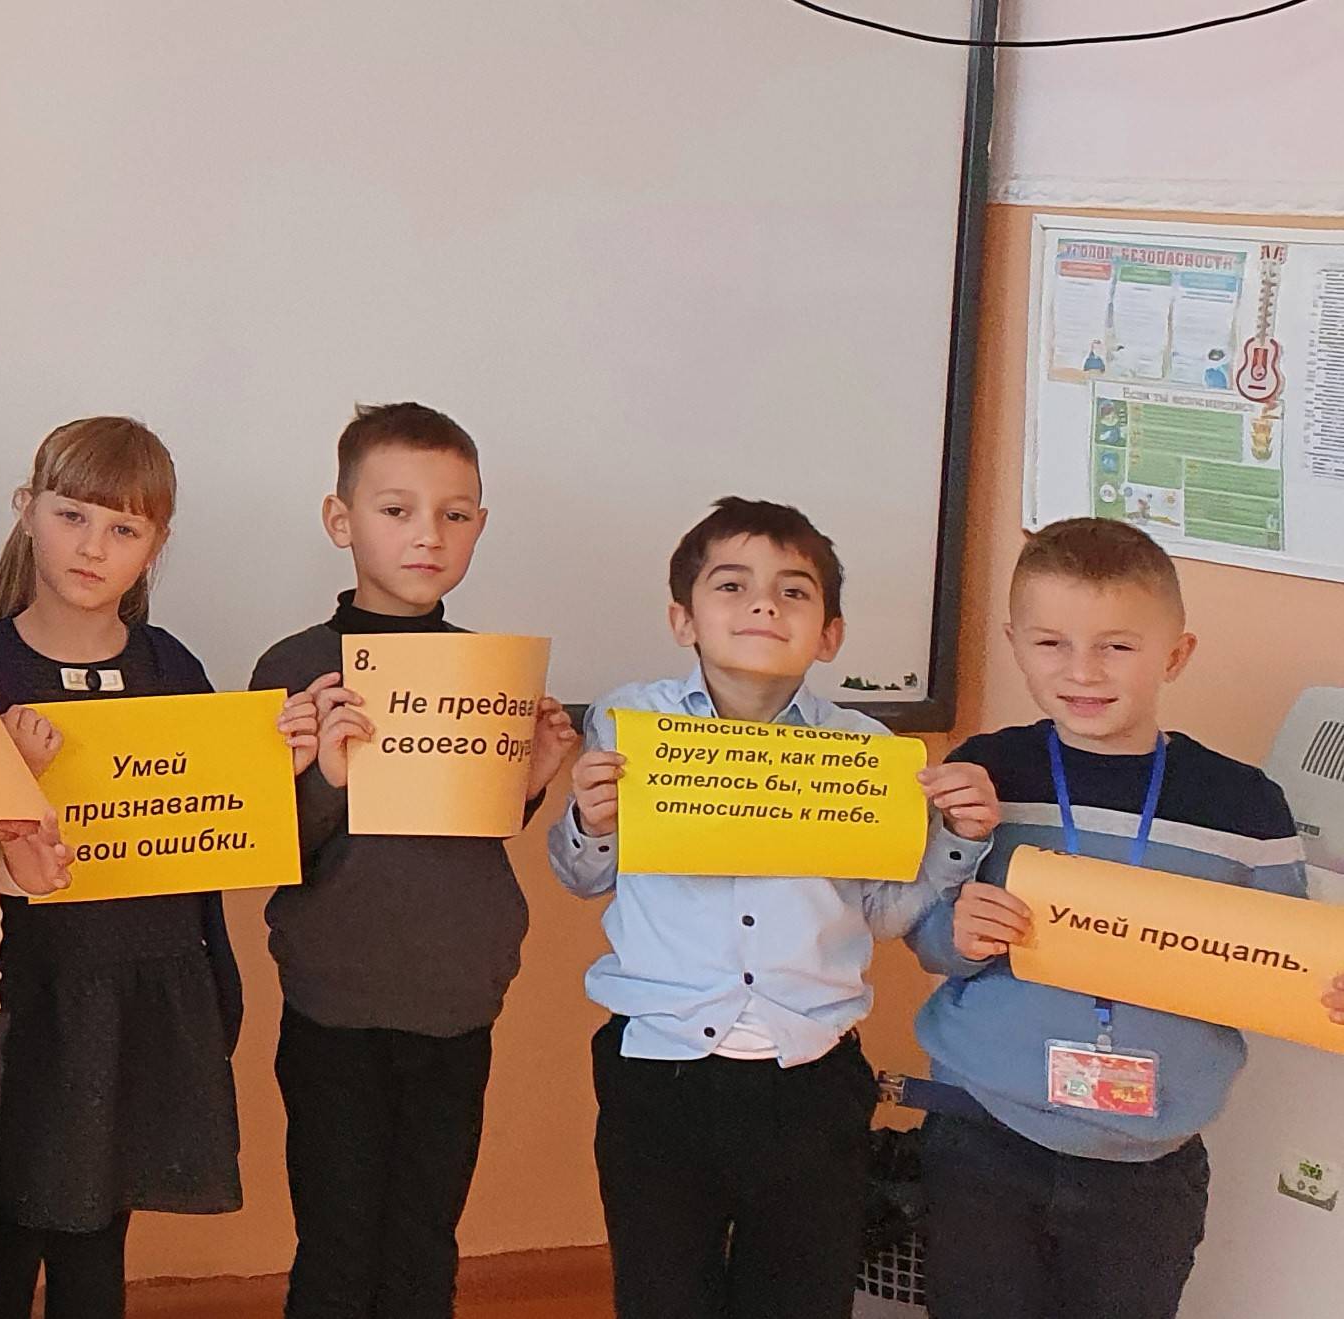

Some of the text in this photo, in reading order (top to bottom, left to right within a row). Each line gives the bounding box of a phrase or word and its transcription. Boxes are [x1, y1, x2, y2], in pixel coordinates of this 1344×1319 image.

[354, 648, 377, 671] 8.
[389, 691, 535, 721] Не предава
[381, 736, 487, 755] своего
[656, 717, 873, 746] Относись к своему
[112, 751, 187, 779] Умей
[655, 742, 879, 769] другу так, как тебе
[646, 773, 888, 797] хотелось бы, чтобы
[65, 793, 244, 828] признавать
[655, 800, 879, 824] относились к тебе.
[74, 828, 255, 862] вои ошибки.
[1048, 904, 1308, 973] Умей прощать.
